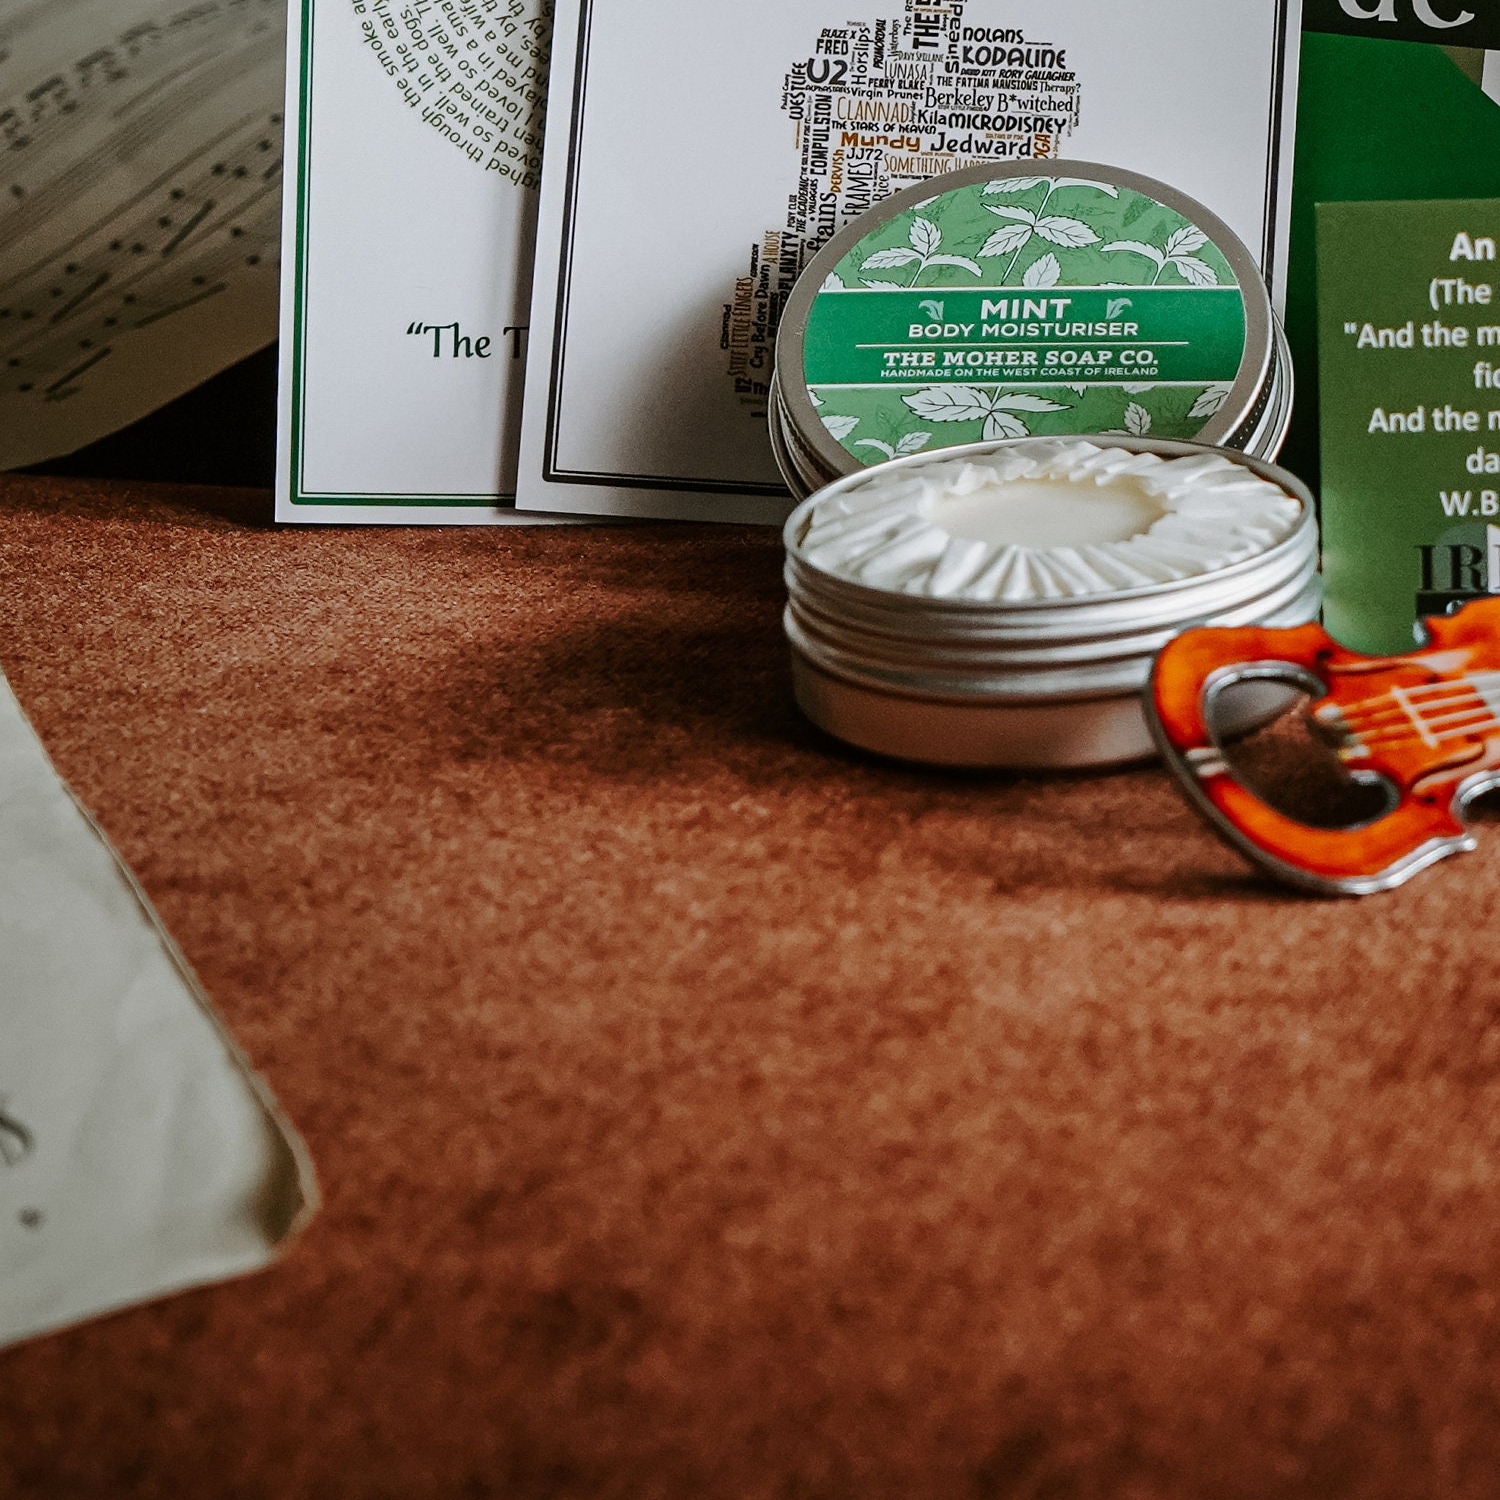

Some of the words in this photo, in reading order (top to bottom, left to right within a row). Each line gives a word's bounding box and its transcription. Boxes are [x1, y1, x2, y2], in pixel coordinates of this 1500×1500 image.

[400, 4, 429, 51] dogs.
[913, 13, 941, 49] THE
[945, 4, 963, 73] Sinéad
[361, 20, 399, 76] smoke
[396, 43, 419, 73] the
[816, 39, 848, 55] FRED
[851, 28, 873, 85] Horslips
[963, 46, 1066, 69] KODALINE
[427, 53, 451, 83] the
[807, 58, 848, 86] U2
[999, 70, 1024, 79] RORY
[1025, 71, 1075, 81] GALLAGHER
[396, 78, 421, 108] the
[417, 73, 435, 92] In
[789, 62, 808, 120] WESTLIFE
[851, 88, 882, 100] Virgin
[887, 89, 924, 100] Prunes
[937, 76, 952, 86] THE
[956, 77, 990, 88] FATIMA
[992, 79, 1038, 90] MANSIONS
[1040, 82, 1081, 94] Therapy?
[434, 91, 470, 127] well.
[448, 81, 509, 133] trained
[838, 97, 909, 123] CLANNAD
[925, 87, 994, 111] Berkeley
[918, 110, 946, 126] Kila
[948, 113, 1066, 134] MICRODISNEY
[421, 106, 484, 163] through
[472, 125, 494, 143] so
[810, 94, 832, 176] COMPULSION
[841, 132, 920, 152] Mundy
[931, 132, 1031, 156] Jedward
[846, 148, 883, 160] JJ72
[1450, 233, 1495, 260] An
[1430, 278, 1492, 310] (The
[981, 299, 1072, 320] MINT
[908, 322, 974, 338] BODY
[982, 322, 1138, 337] MOISTURISER
[1344, 322, 1413, 348] "And
[1421, 324, 1468, 347] the
[880, 368, 951, 378] HANDMADE
[954, 368, 972, 376] ON
[976, 367, 1000, 376] THE
[1001, 367, 1038, 376] WEST
[1041, 366, 1081, 376] COAST
[1084, 366, 1101, 376] OF
[1104, 366, 1159, 376] IRELAND
[883, 352, 936, 367] THE
[942, 351, 1040, 367] MOHER
[1045, 351, 1113, 368] SOAP
[1119, 351, 1159, 366] CO.
[1368, 407, 1425, 433] And
[1432, 406, 1479, 432] the
[1440, 492, 1498, 517] W.B
